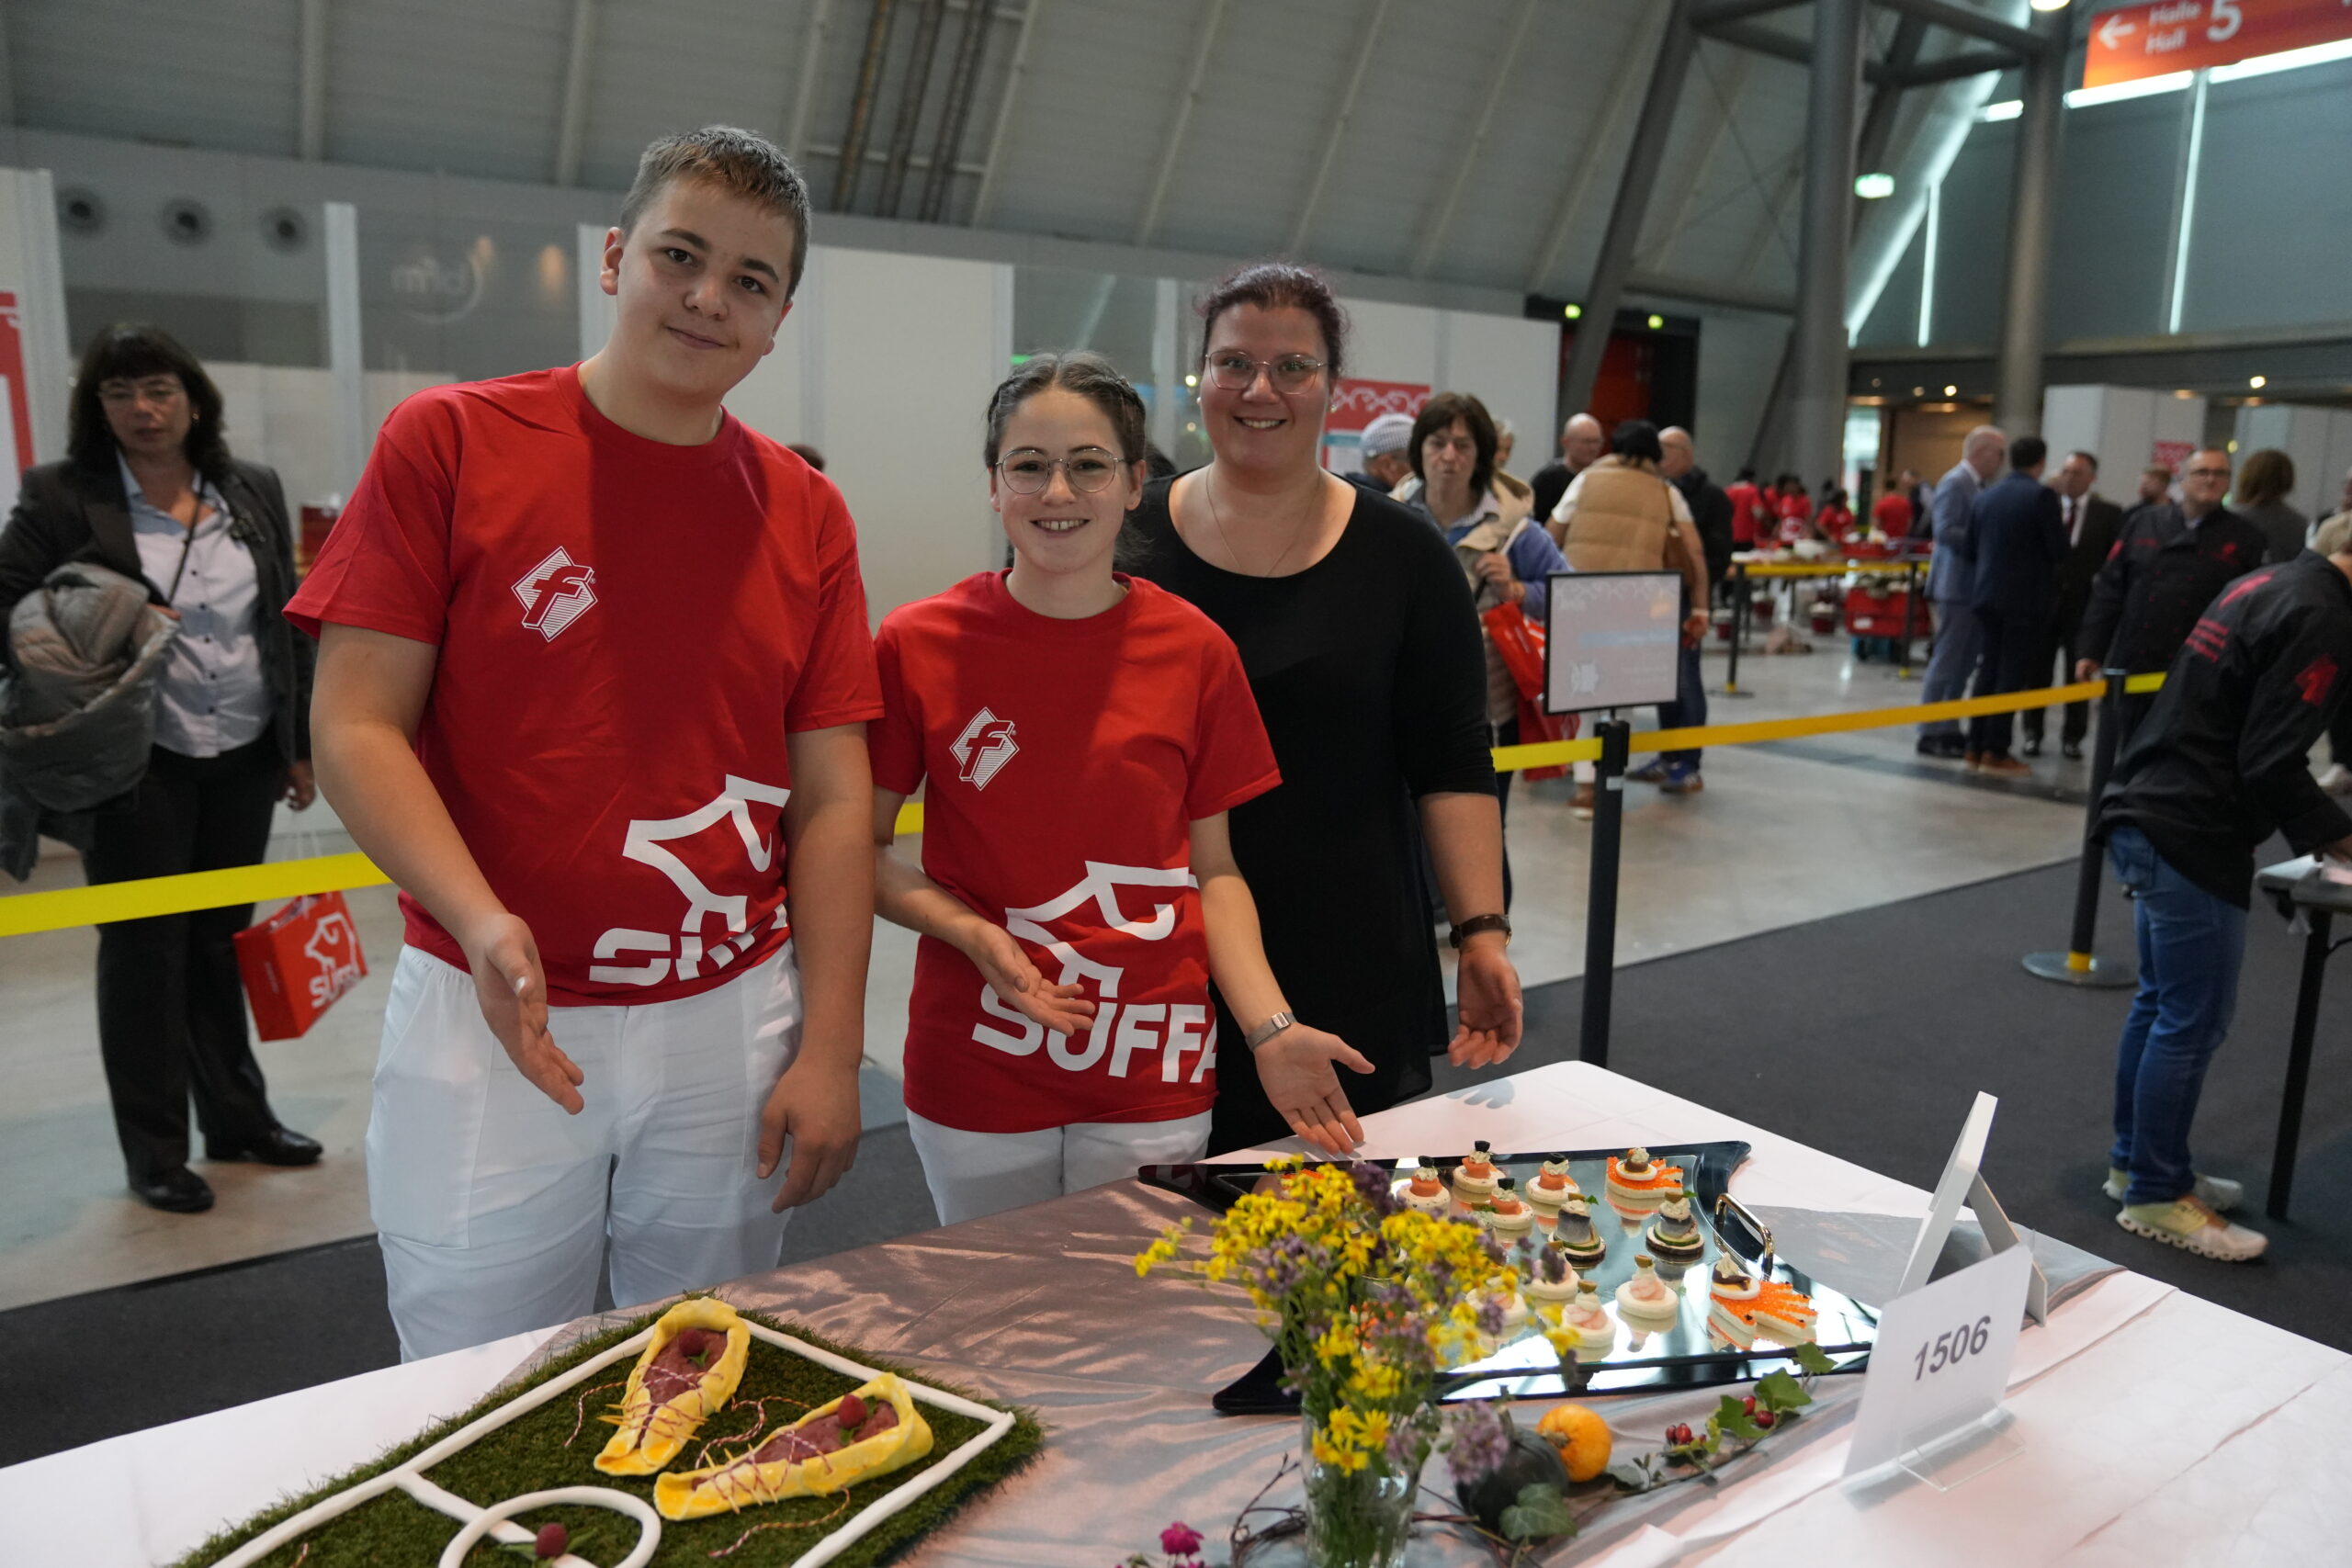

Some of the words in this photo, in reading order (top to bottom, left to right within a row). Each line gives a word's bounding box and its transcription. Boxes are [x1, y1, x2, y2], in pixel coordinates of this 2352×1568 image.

[2148, 2, 2201, 26] Halle
[2207, 0, 2243, 42] 5
[2145, 27, 2187, 54] Hall
[1914, 1314, 1992, 1382] 1506
